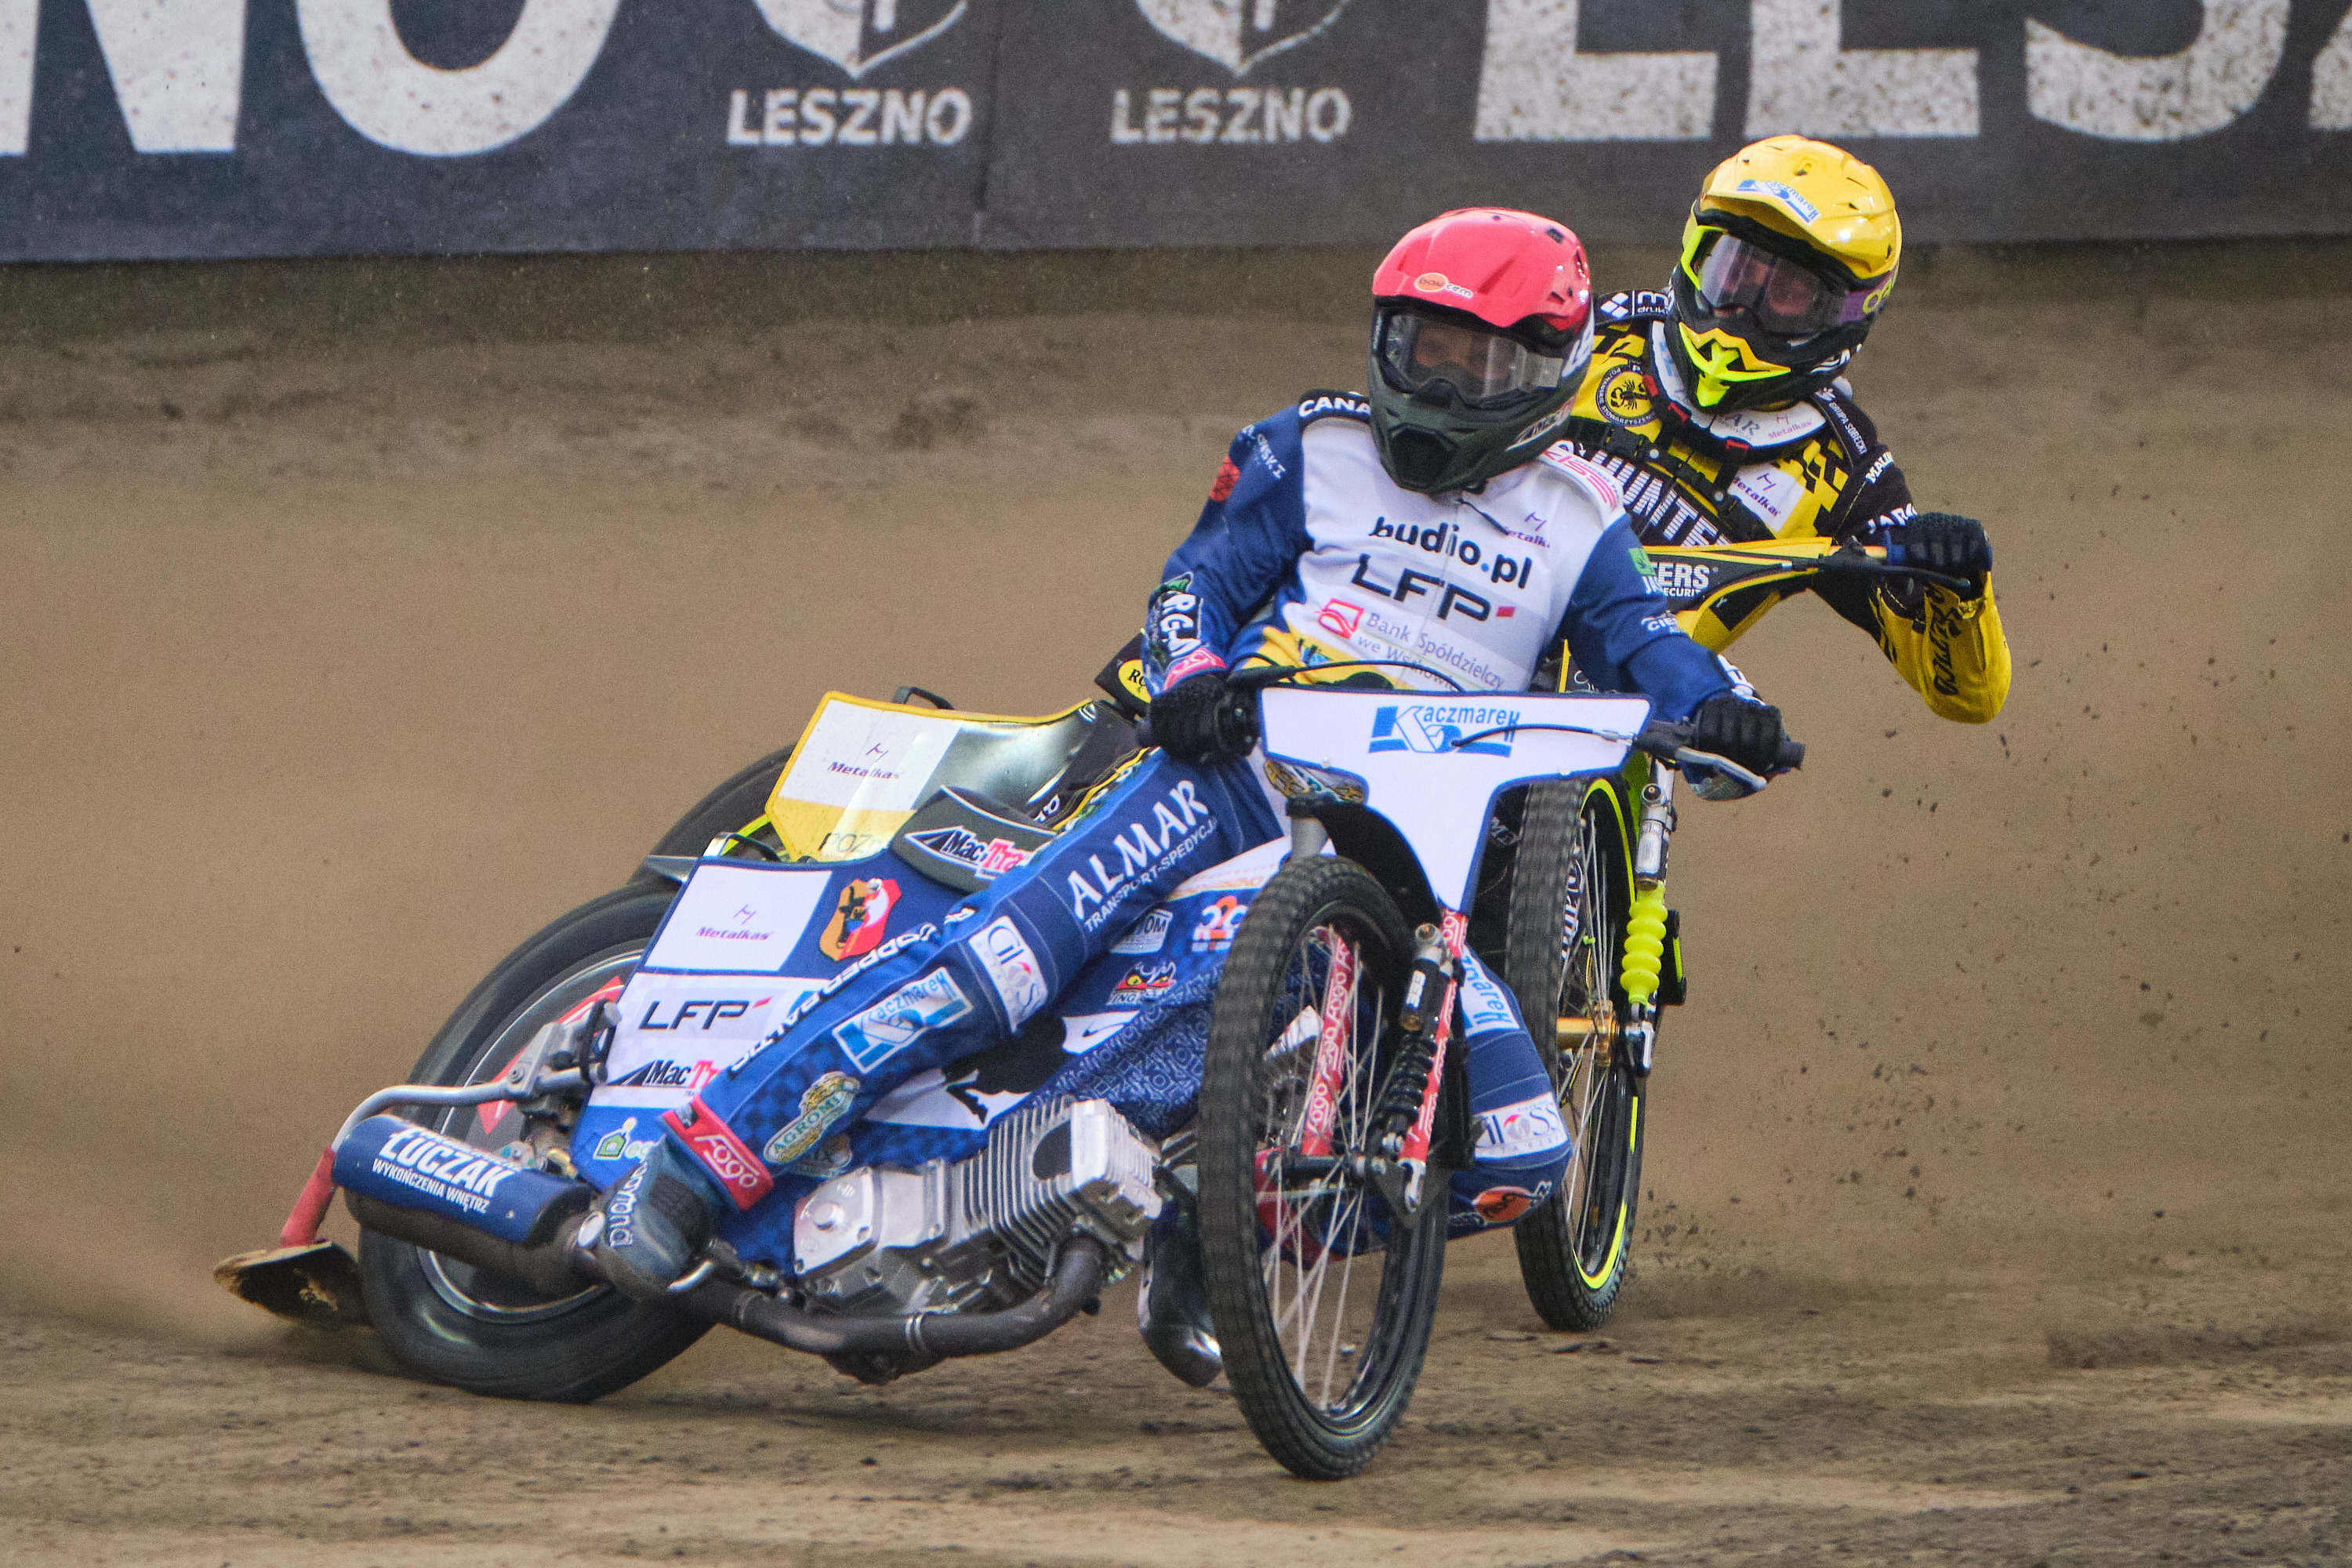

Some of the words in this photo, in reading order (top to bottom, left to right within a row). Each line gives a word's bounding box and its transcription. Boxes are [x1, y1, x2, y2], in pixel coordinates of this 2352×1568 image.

[725, 86, 973, 146] LESZNO
[1109, 86, 1352, 145] LESZNO
[1369, 516, 1533, 590] budio.pl
[1351, 553, 1492, 622] LFP
[1357, 634, 1381, 654] we
[1366, 612, 1412, 644] Bank
[1417, 632, 1506, 691] Spółdzielczy
[827, 761, 902, 780] Metalkas
[1067, 779, 1209, 920] ALMAR
[695, 925, 774, 942] Metalkas
[637, 998, 750, 1031] LFP
[371, 1156, 446, 1199] WYKOŃCZENIA
[445, 1185, 492, 1214] WNĘTRZ
[378, 1127, 514, 1200] ŁUCZAK
